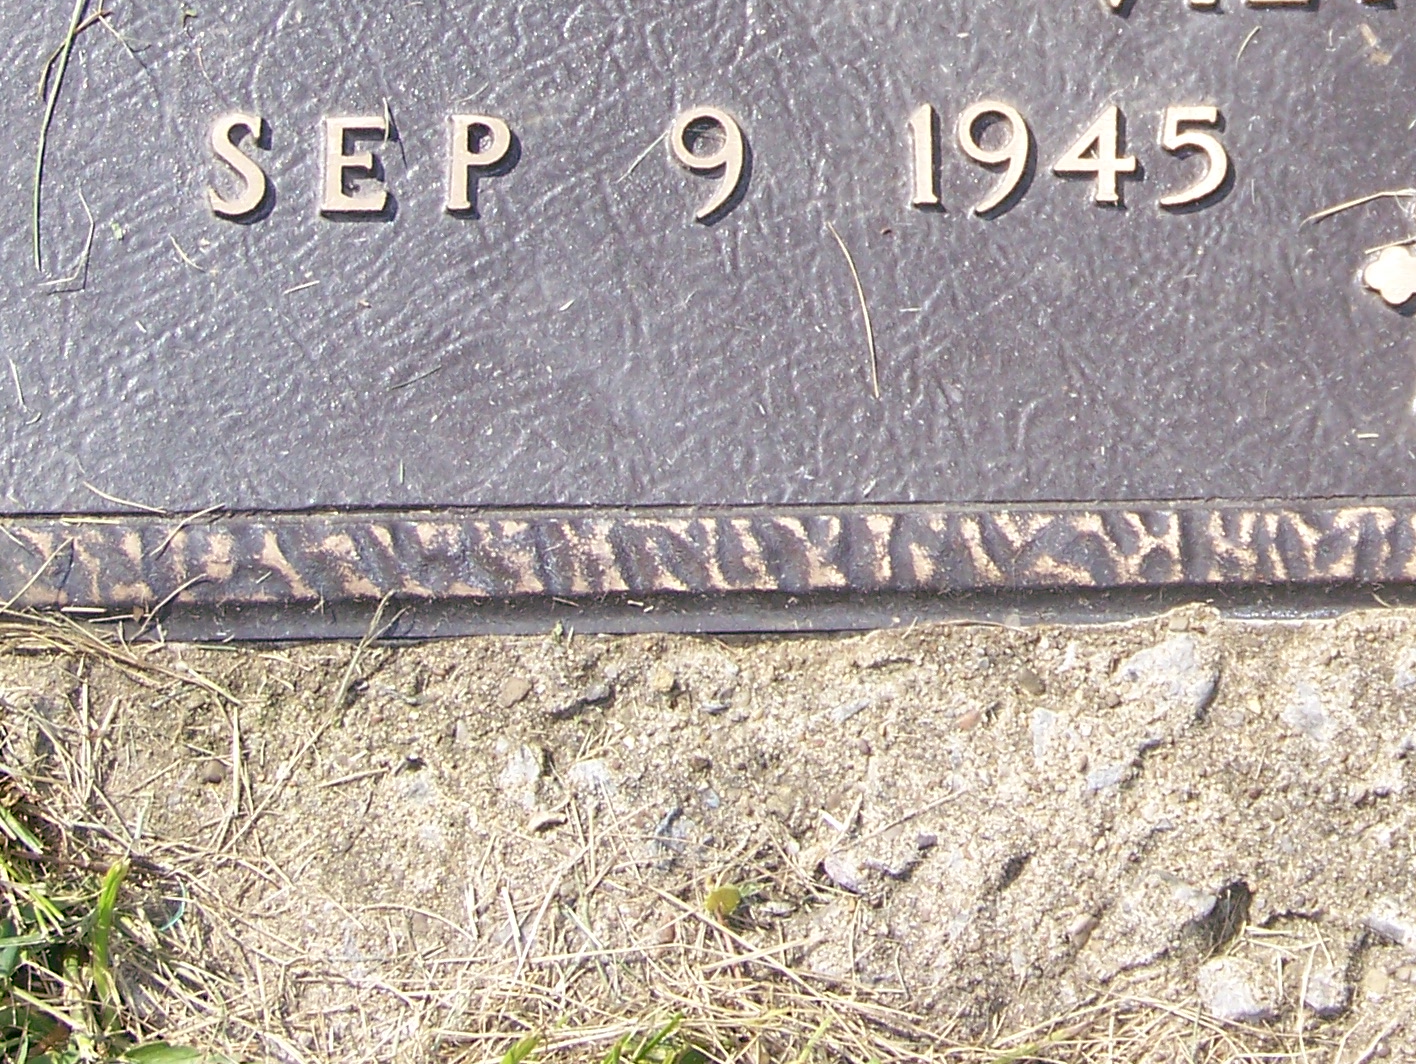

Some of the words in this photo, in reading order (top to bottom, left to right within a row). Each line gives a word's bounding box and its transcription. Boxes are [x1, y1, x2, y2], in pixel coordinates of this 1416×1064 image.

[206, 112, 516, 220] SEP
[670, 105, 747, 223] 9
[908, 100, 1231, 217] 1945
